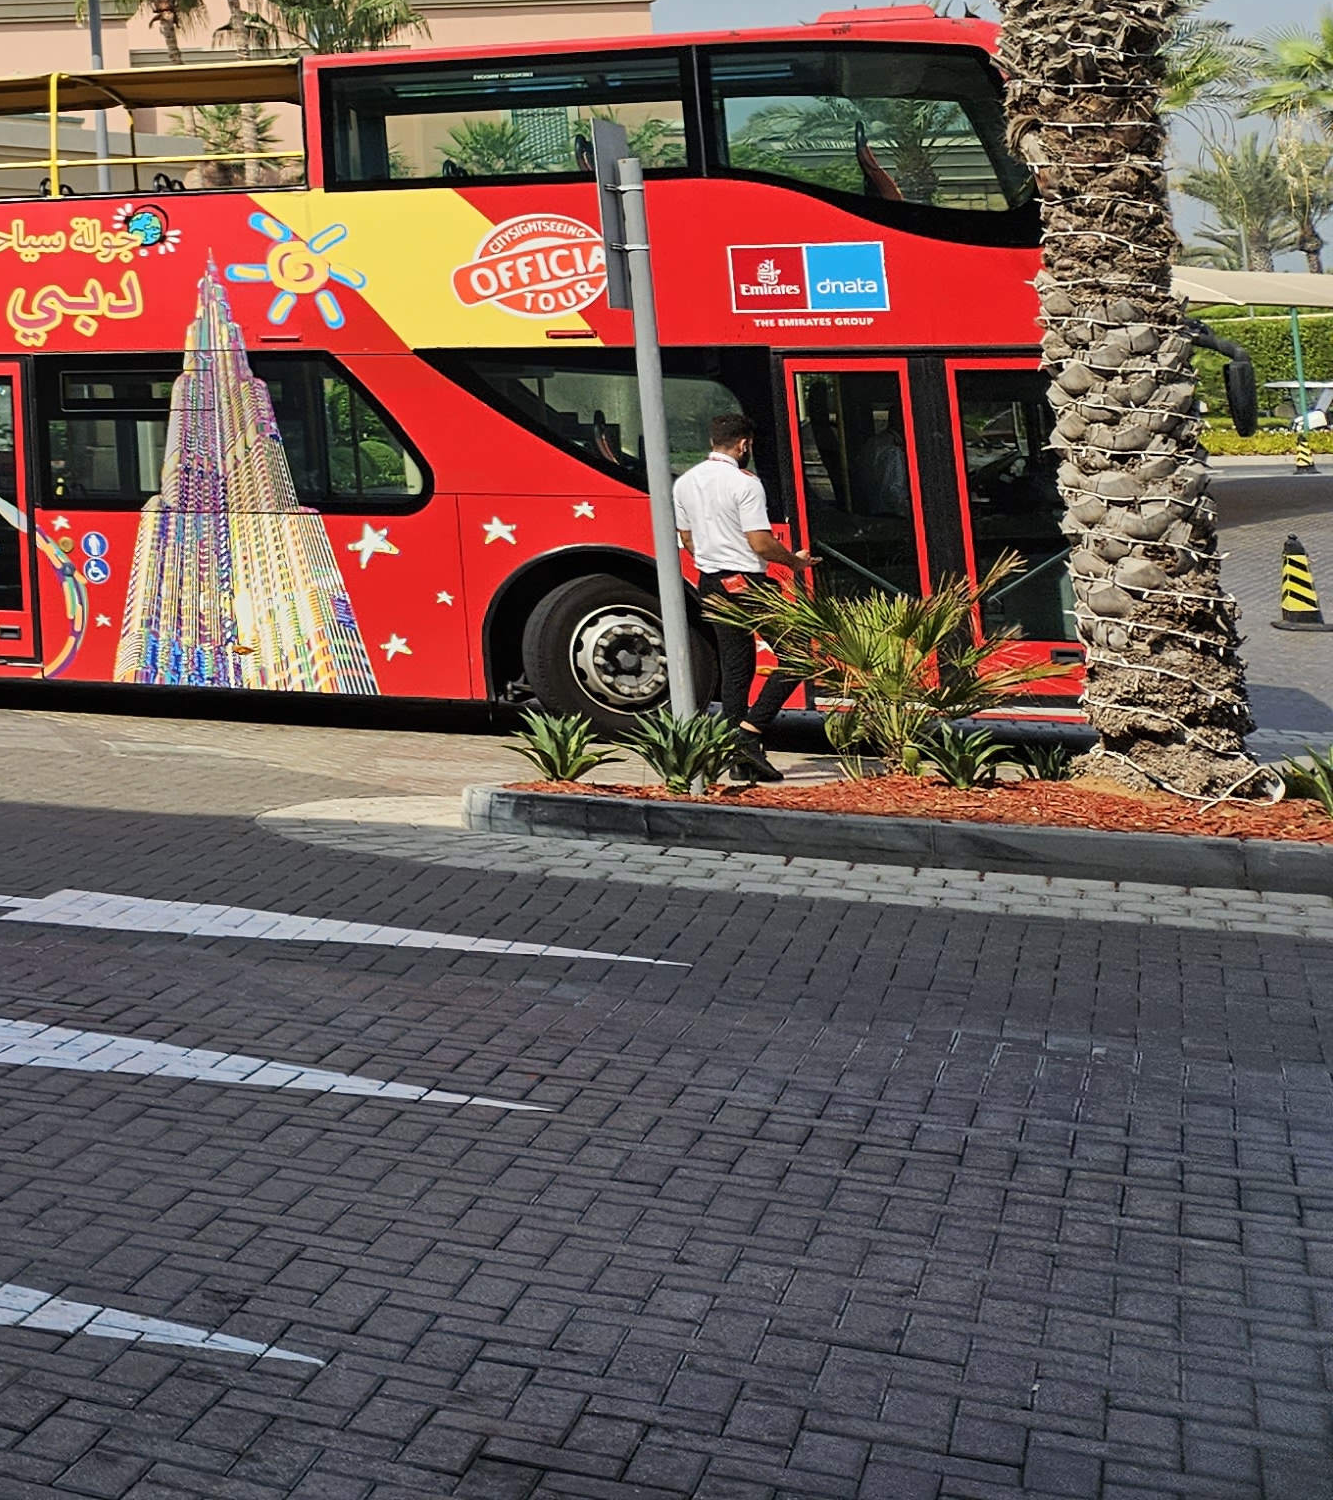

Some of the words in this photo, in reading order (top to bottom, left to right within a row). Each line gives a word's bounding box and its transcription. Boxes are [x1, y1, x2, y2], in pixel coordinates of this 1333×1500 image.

[69, 217, 142, 263] جولة
[469, 245, 606, 297] OFFICIA
[816, 277, 879, 295] dnata
[523, 280, 596, 312] TOUR
[739, 283, 801, 296] Emirates
[6, 270, 143, 347] دبي
[753, 318, 776, 327] THE
[778, 317, 832, 327] EMIRATES
[834, 316, 875, 326] GROUP
